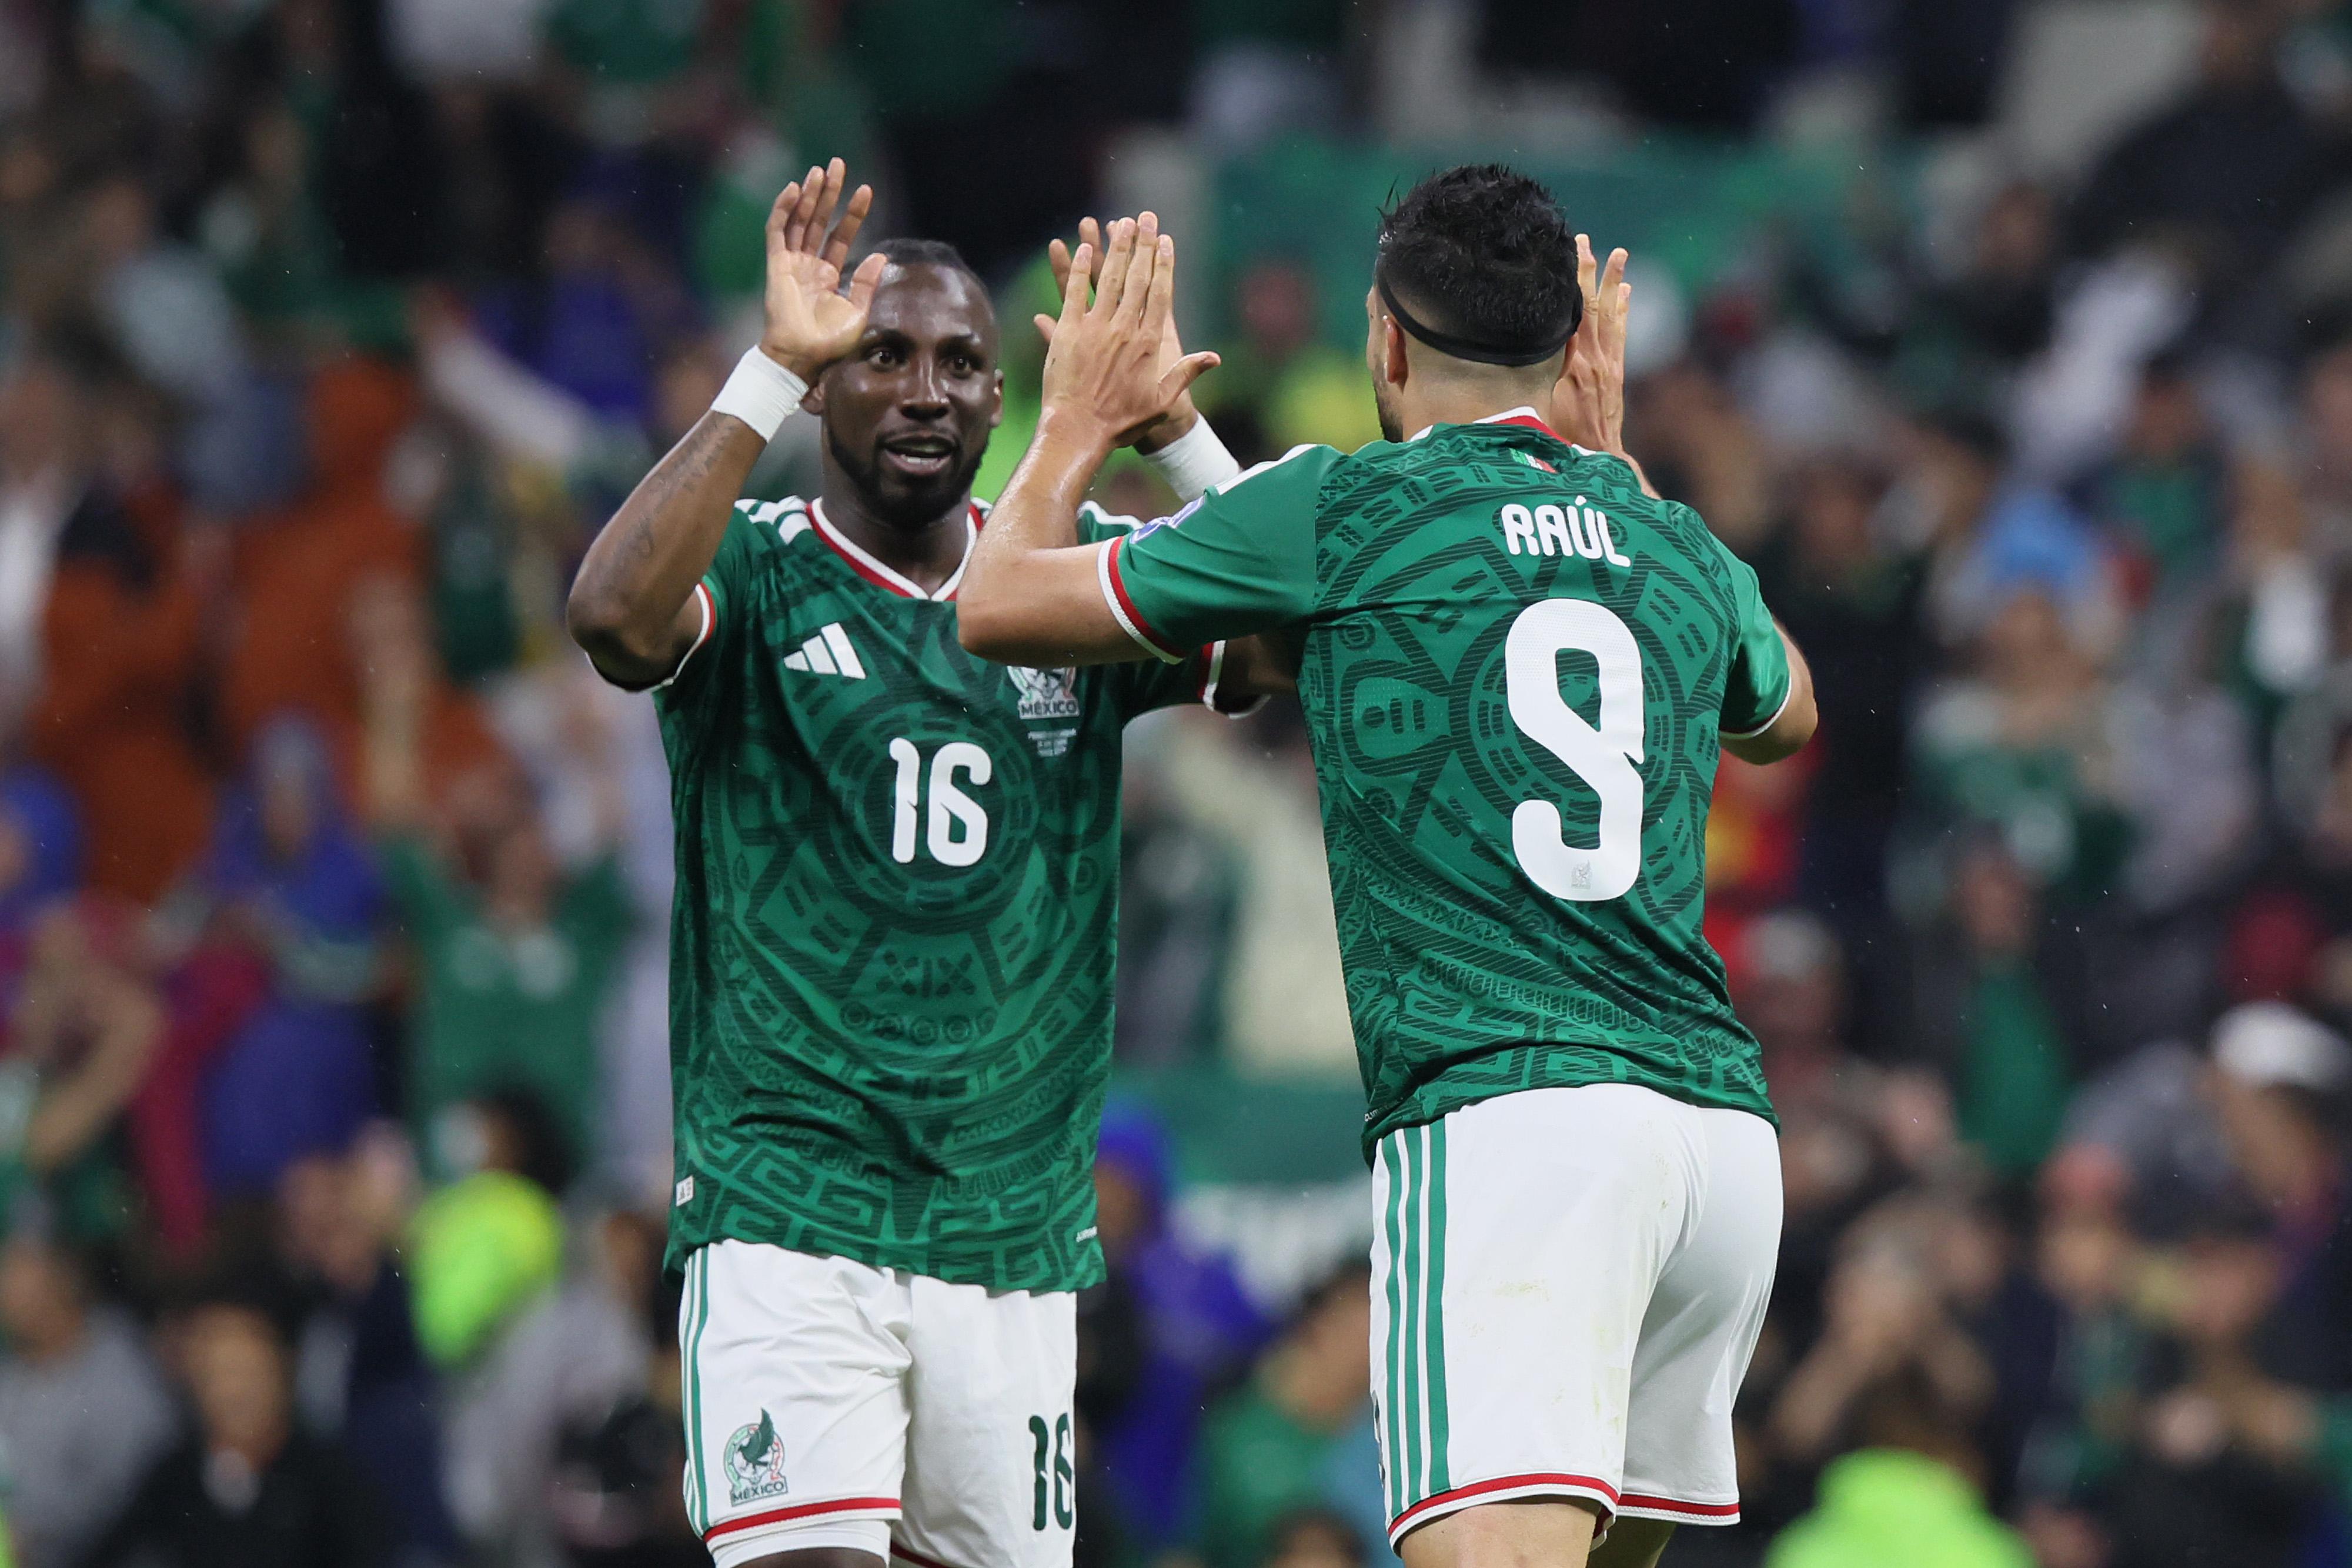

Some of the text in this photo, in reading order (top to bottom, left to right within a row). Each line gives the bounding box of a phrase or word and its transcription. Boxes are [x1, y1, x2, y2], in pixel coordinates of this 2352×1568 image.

[1501, 495, 1631, 567] RAÚL
[889, 737, 991, 867] 16
[1505, 598, 1645, 901] 9
[1028, 1412, 1072, 1531] 16
